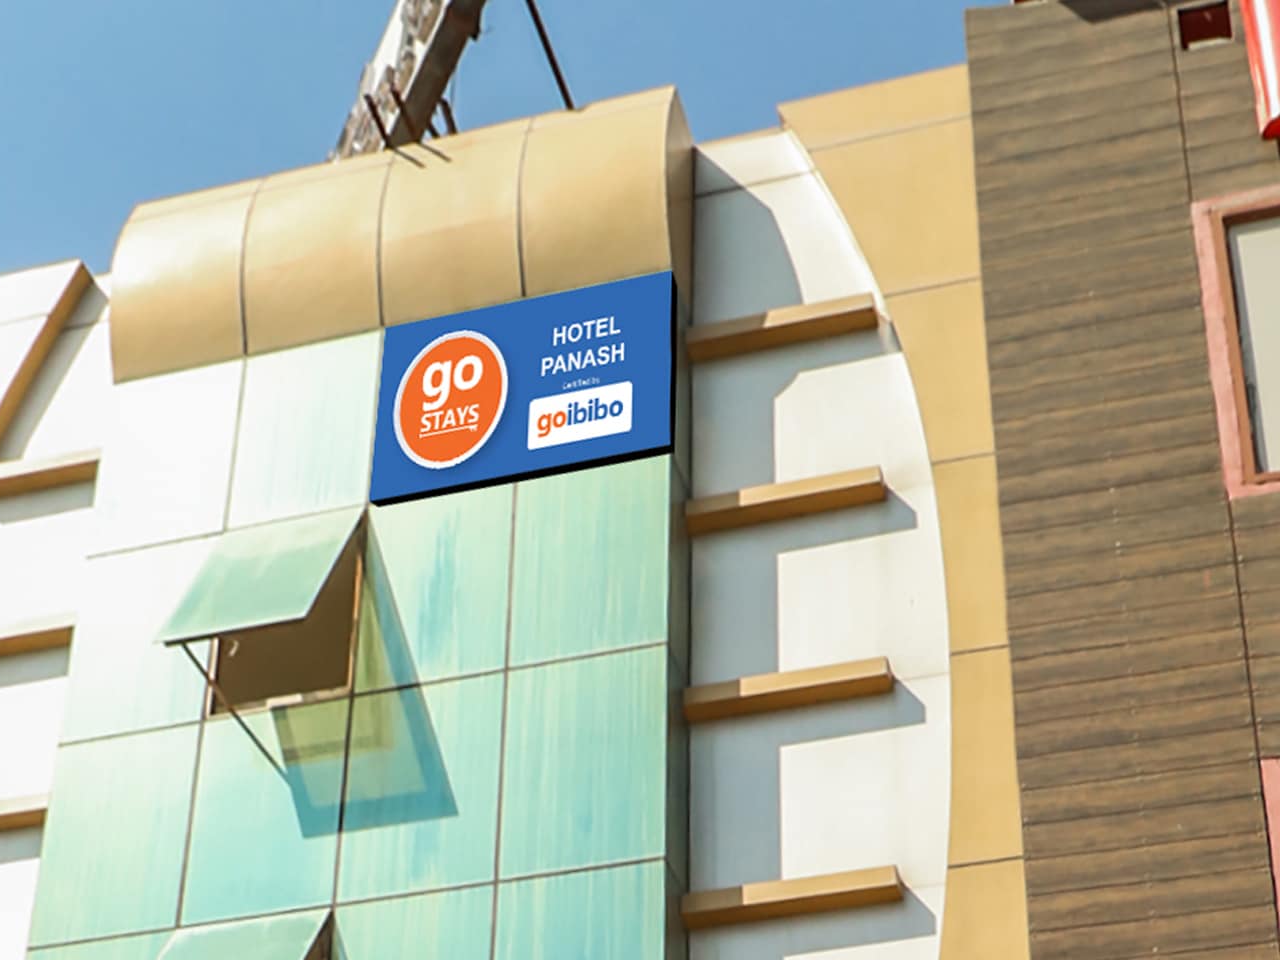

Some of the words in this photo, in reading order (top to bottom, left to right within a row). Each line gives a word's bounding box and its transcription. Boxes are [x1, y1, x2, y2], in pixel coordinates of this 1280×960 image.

[552, 316, 621, 346] HOTEL
[540, 343, 625, 377] PANASH
[422, 355, 484, 411] go
[420, 403, 480, 433] STAYS
[537, 399, 624, 438] goibibo
